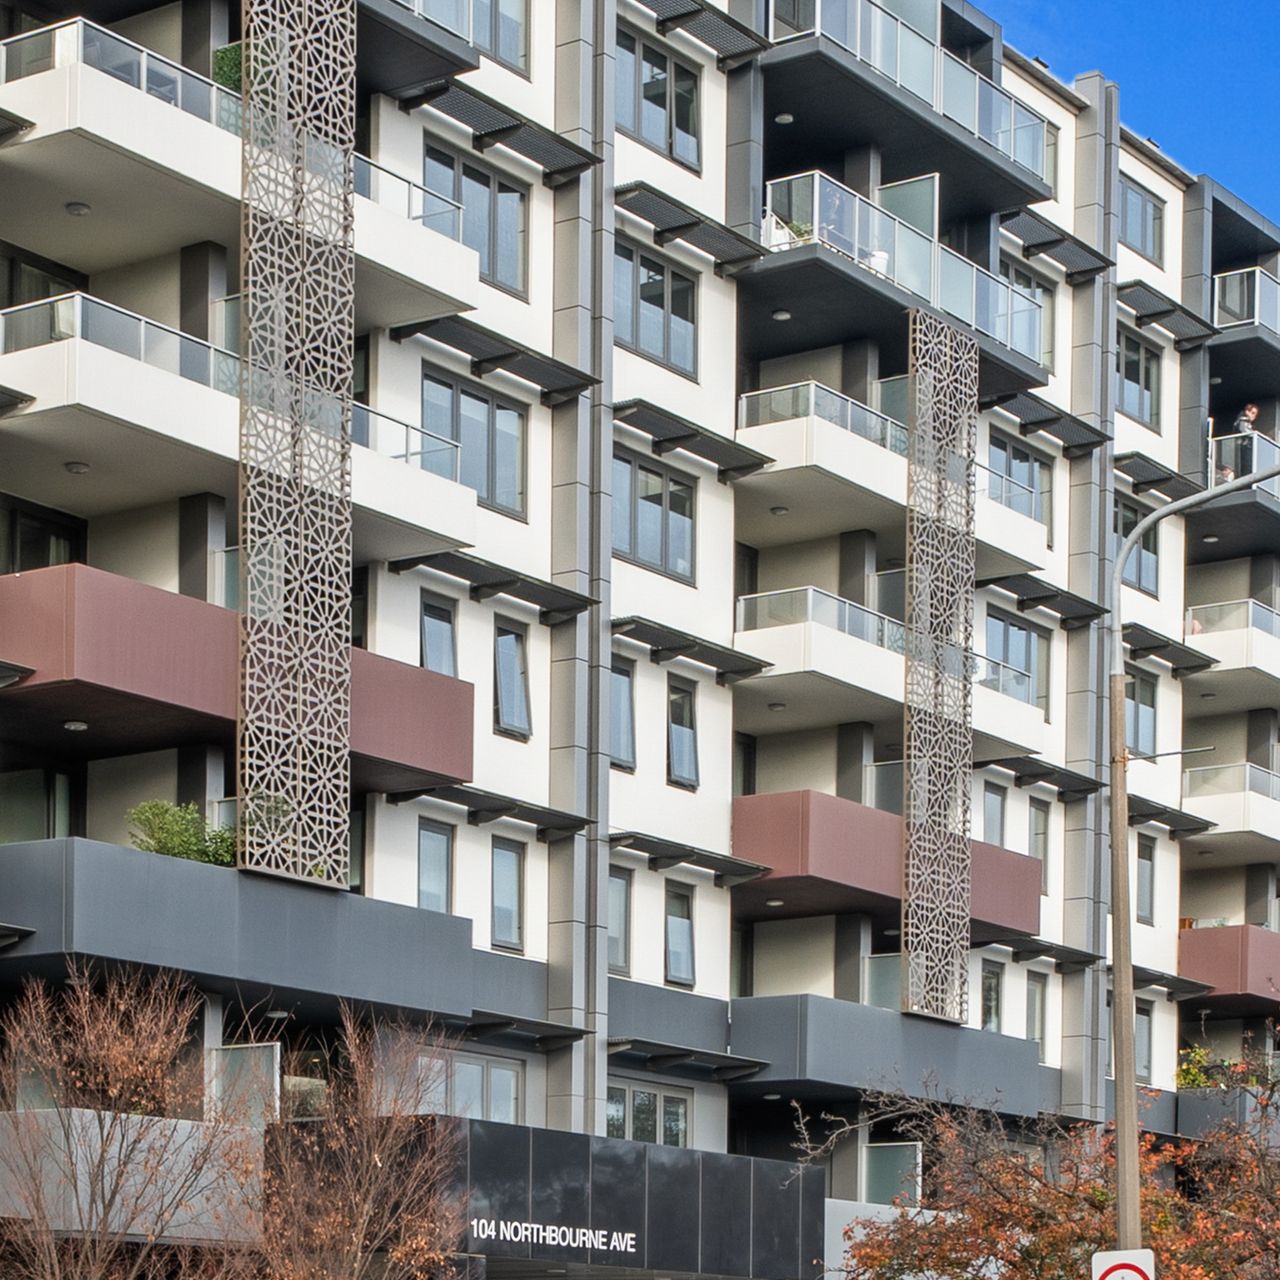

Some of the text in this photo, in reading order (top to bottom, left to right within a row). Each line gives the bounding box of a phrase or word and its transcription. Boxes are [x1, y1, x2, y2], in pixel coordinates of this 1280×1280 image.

[470, 1218, 636, 1252] 104 NORTHBOURNE AVE
